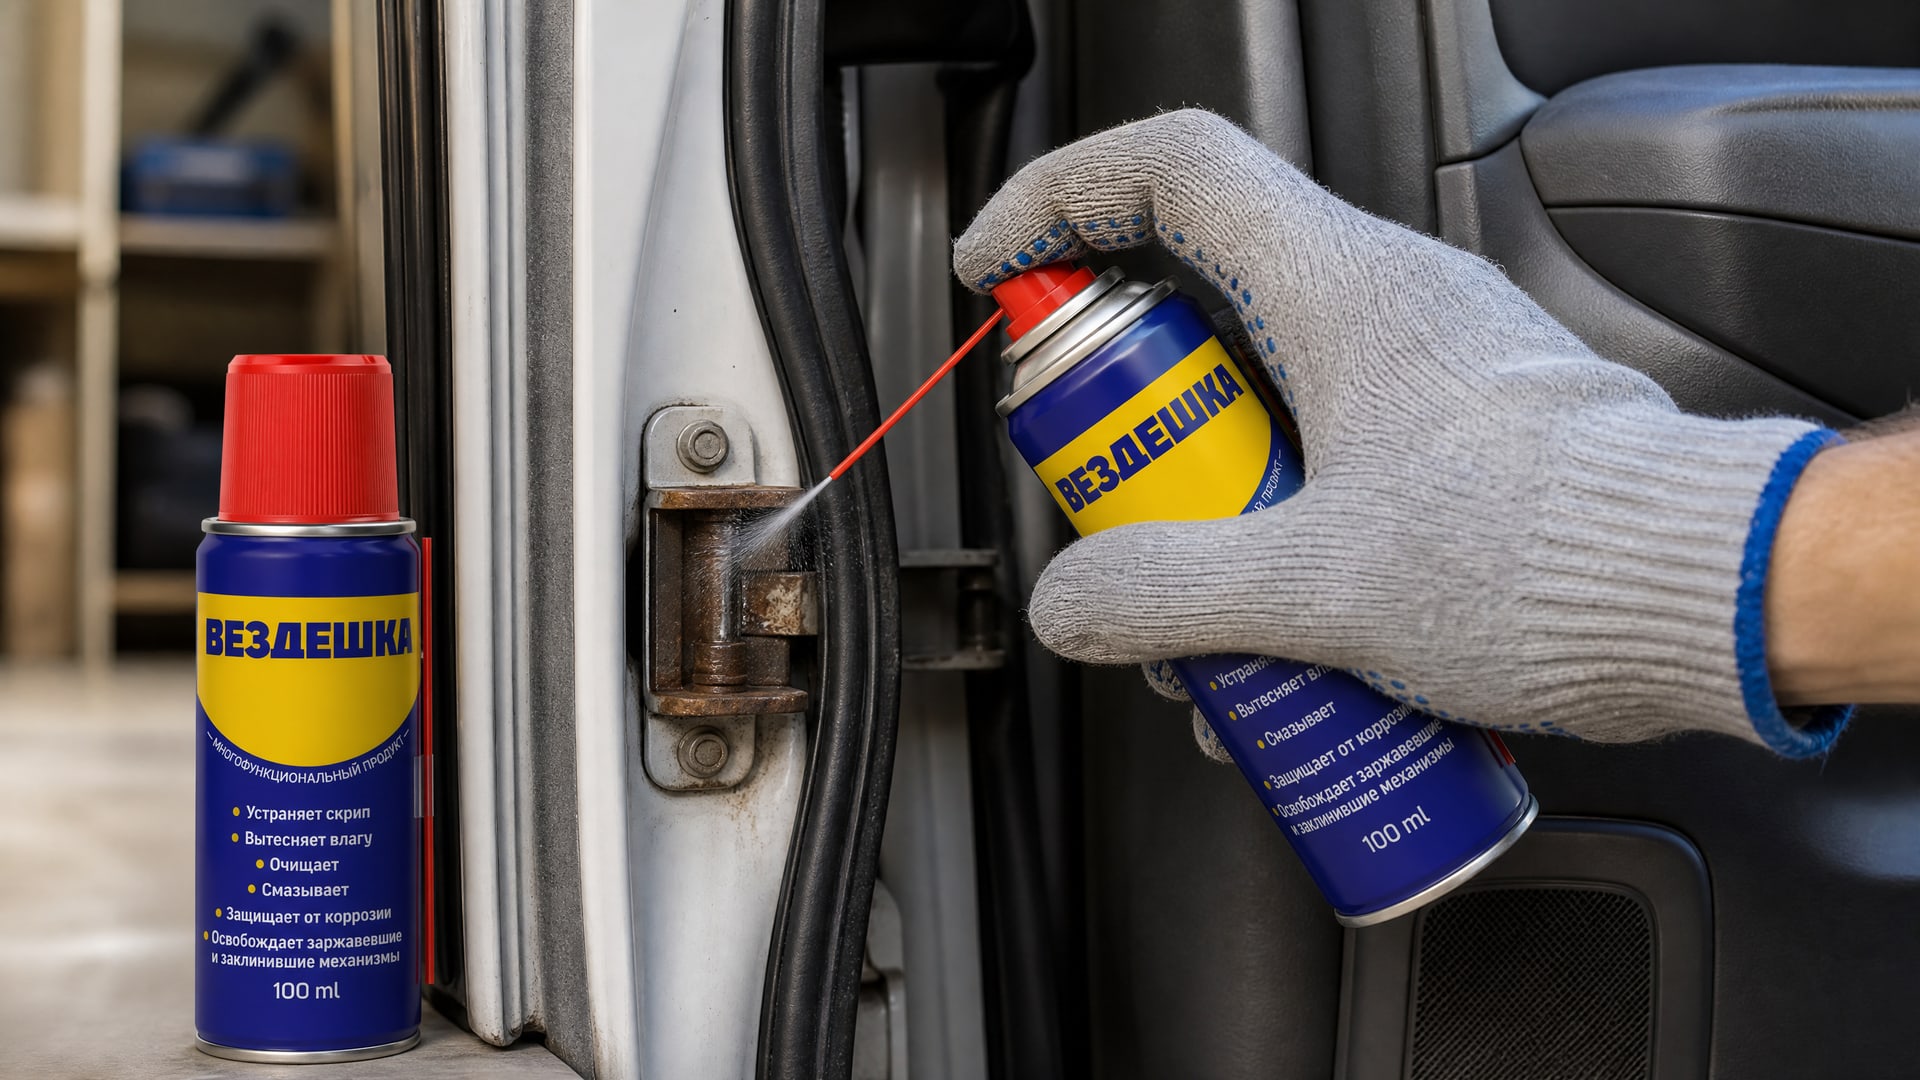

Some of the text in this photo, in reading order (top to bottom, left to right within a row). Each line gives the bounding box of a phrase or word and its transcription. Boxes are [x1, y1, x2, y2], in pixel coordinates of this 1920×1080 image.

[1054, 363, 1245, 514] ВЕЗДЕШКА
[205, 617, 413, 659] ВЕЗДЕШКА
[1215, 655, 1277, 689] Устраняе
[1235, 674, 1306, 719] Вытесняет
[1264, 701, 1337, 747] Смазывает
[212, 735, 405, 784] МНОГОФУНКЦИОНАЛЬНЫЙ ПРОДУКТ
[1269, 750, 1337, 790] Защищает
[1338, 739, 1356, 757] от
[1277, 718, 1444, 819] Освобождает заржавевшие
[1290, 737, 1456, 836] и заклинившие механизмы
[246, 805, 371, 823] Устраняет скрип
[1361, 805, 1432, 853] 100 ml
[245, 831, 373, 848] Вытесняет влагу
[269, 857, 339, 874] Очищает
[261, 883, 349, 897] Смазывает
[226, 906, 392, 926] Защищает от коррозии
[211, 930, 402, 952] Освобождает заржавевшие
[211, 951, 400, 969] и заклинившие механизмы
[272, 981, 341, 999] 100 ml
